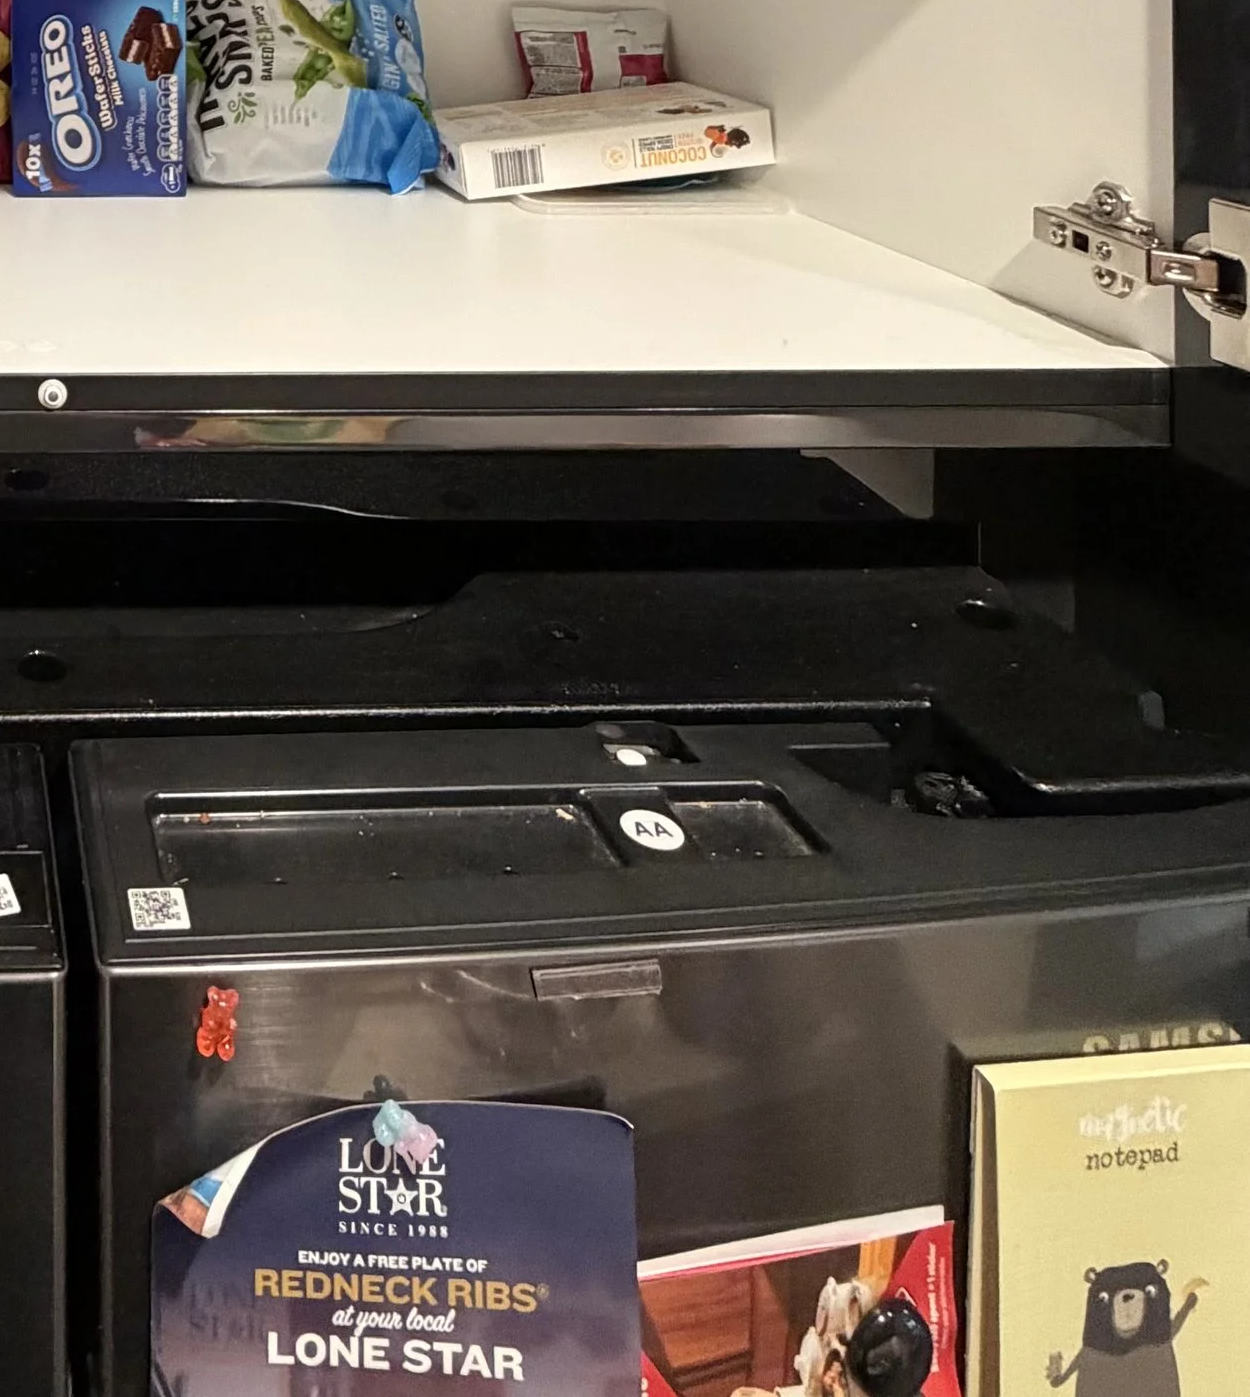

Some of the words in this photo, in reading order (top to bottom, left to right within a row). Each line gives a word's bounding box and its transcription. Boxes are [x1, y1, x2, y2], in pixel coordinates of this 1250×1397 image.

[99, 30, 117, 80] Chocolate
[261, 47, 275, 81] BAKED
[44, 17, 93, 165] OREO
[110, 80, 125, 106] Milk
[25, 143, 41, 180] 10x
[640, 146, 707, 168] COCONUT
[634, 821, 674, 838] AA
[1082, 1021, 1241, 1052] SAMS
[1086, 1141, 1180, 1171] notepad
[338, 1220, 398, 1237] SINCE
[408, 1224, 448, 1239] 1988
[298, 1250, 351, 1267] ENJOY
[353, 1252, 365, 1267] A
[367, 1253, 410, 1270] FREE
[411, 1255, 464, 1272] PLATE
[466, 1258, 488, 1273] OF
[254, 1269, 438, 1305] REDNECK
[332, 1309, 353, 1326] at
[353, 1310, 403, 1337] your
[406, 1308, 455, 1333] local
[267, 1331, 389, 1370] LONE
[402, 1337, 526, 1382] STAR
